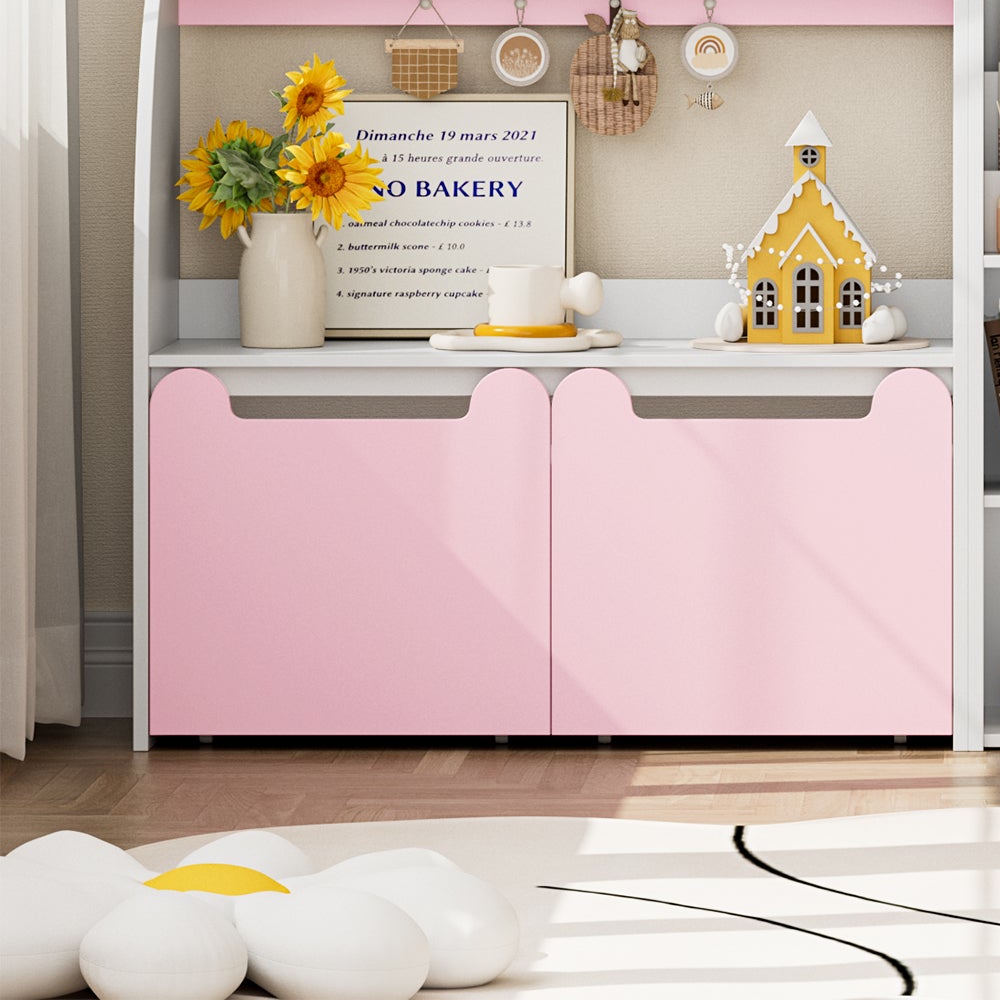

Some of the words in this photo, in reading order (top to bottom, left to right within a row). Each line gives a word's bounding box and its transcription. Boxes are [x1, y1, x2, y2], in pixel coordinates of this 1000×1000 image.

[356, 129, 434, 141] Dimanche
[440, 130, 456, 141] 19
[460, 133, 498, 141] mars
[502, 130, 537, 141] 2021
[382, 154, 387, 162] à
[393, 154, 404, 162] 15
[408, 153, 443, 162] heures
[446, 153, 484, 165] grande
[416, 180, 523, 198] BAKERY
[389, 219, 456, 229] chocolatechip
[458, 219, 495, 228] cookies
[513, 220, 532, 228] 13.8
[337, 243, 345, 251] 2.
[348, 242, 399, 251] buttermilk
[380, 266, 416, 274] victoria
[419, 267, 453, 276] sponge
[455, 266, 477, 274] cake
[336, 290, 344, 298] 4.
[347, 290, 392, 299] signature
[395, 291, 440, 299] raspberry
[443, 290, 483, 299] cupcake
